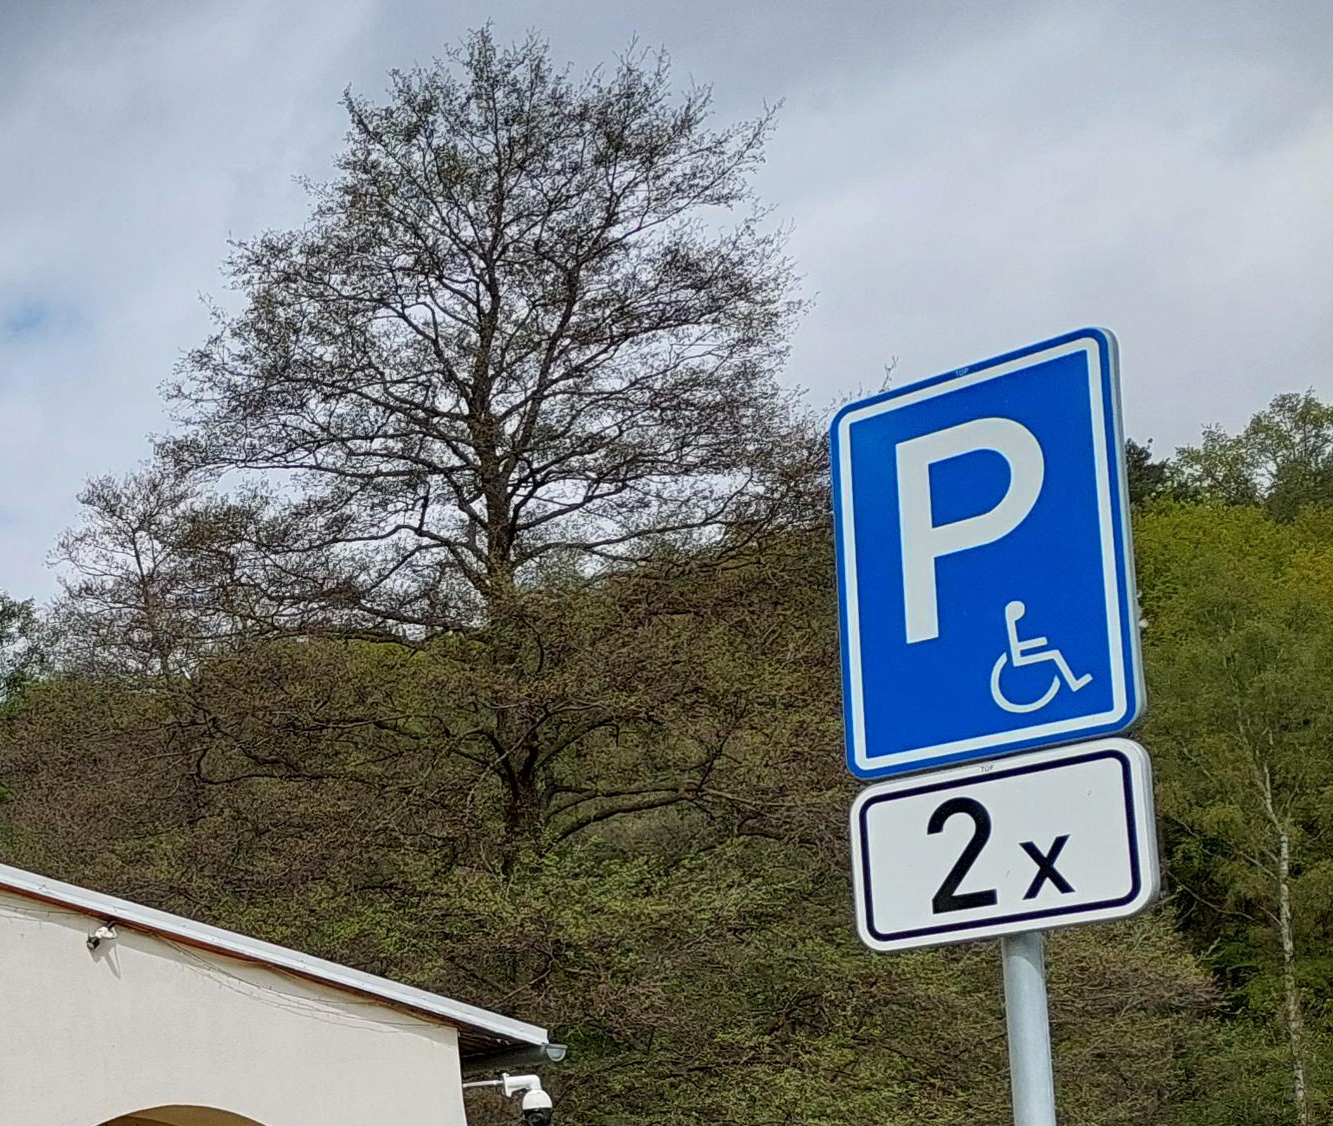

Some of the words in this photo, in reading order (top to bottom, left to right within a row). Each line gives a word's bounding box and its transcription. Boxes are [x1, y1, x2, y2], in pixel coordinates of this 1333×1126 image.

[895, 417, 1044, 644] P
[927, 796, 998, 915] 2
[1018, 834, 1076, 900] x
